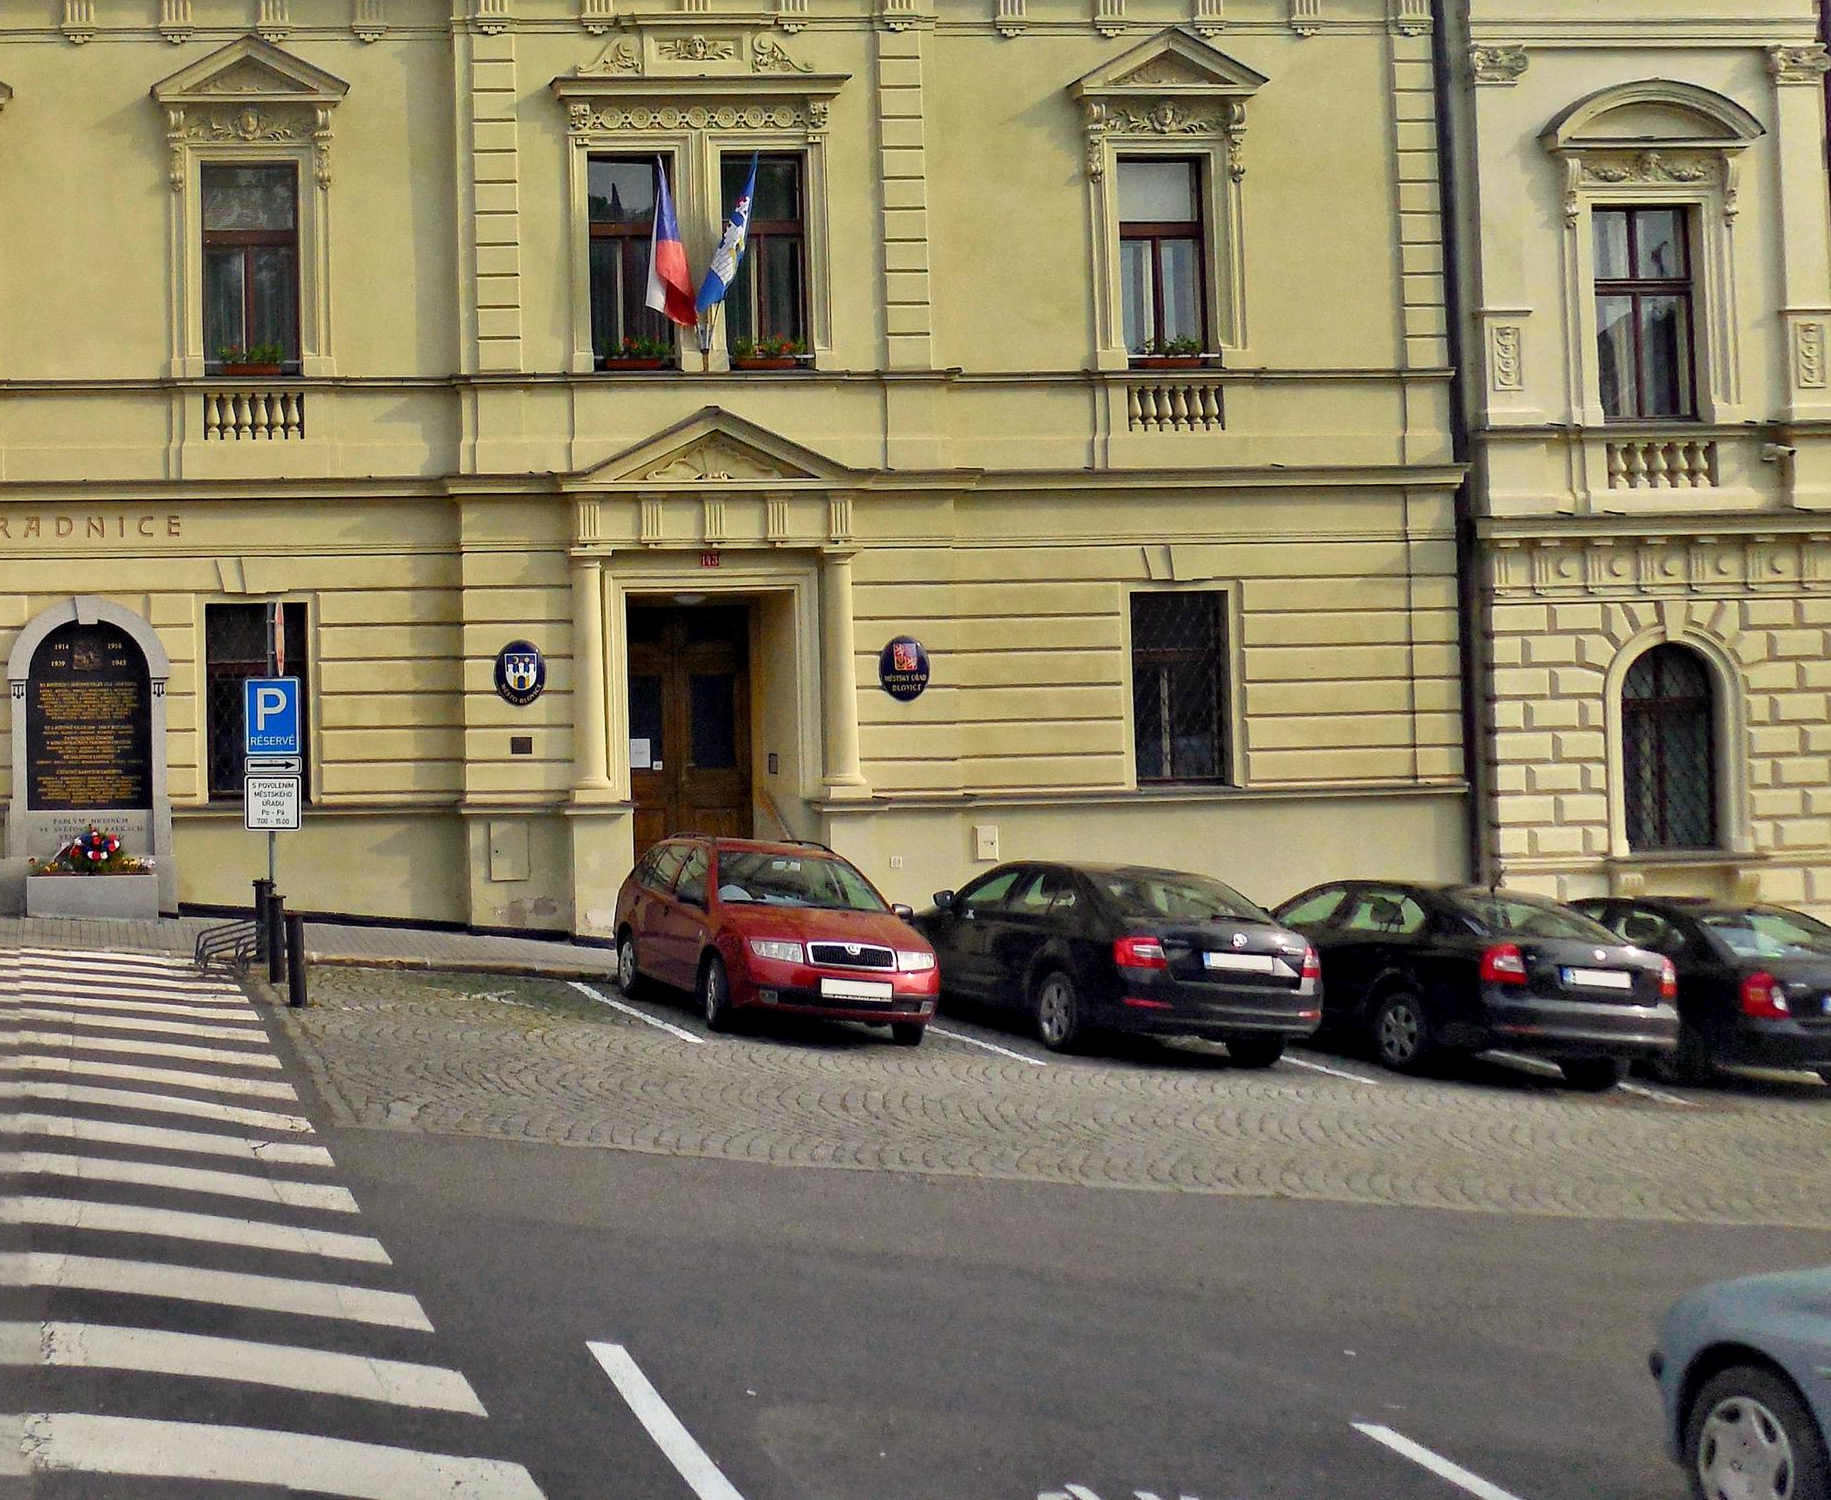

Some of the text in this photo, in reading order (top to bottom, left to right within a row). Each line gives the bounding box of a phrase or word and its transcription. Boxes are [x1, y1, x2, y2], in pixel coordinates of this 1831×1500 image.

[256, 687, 287, 731] P
[250, 734, 295, 746] RÉSERVÉ
[254, 790, 293, 798] MĚSTSKÉHO
